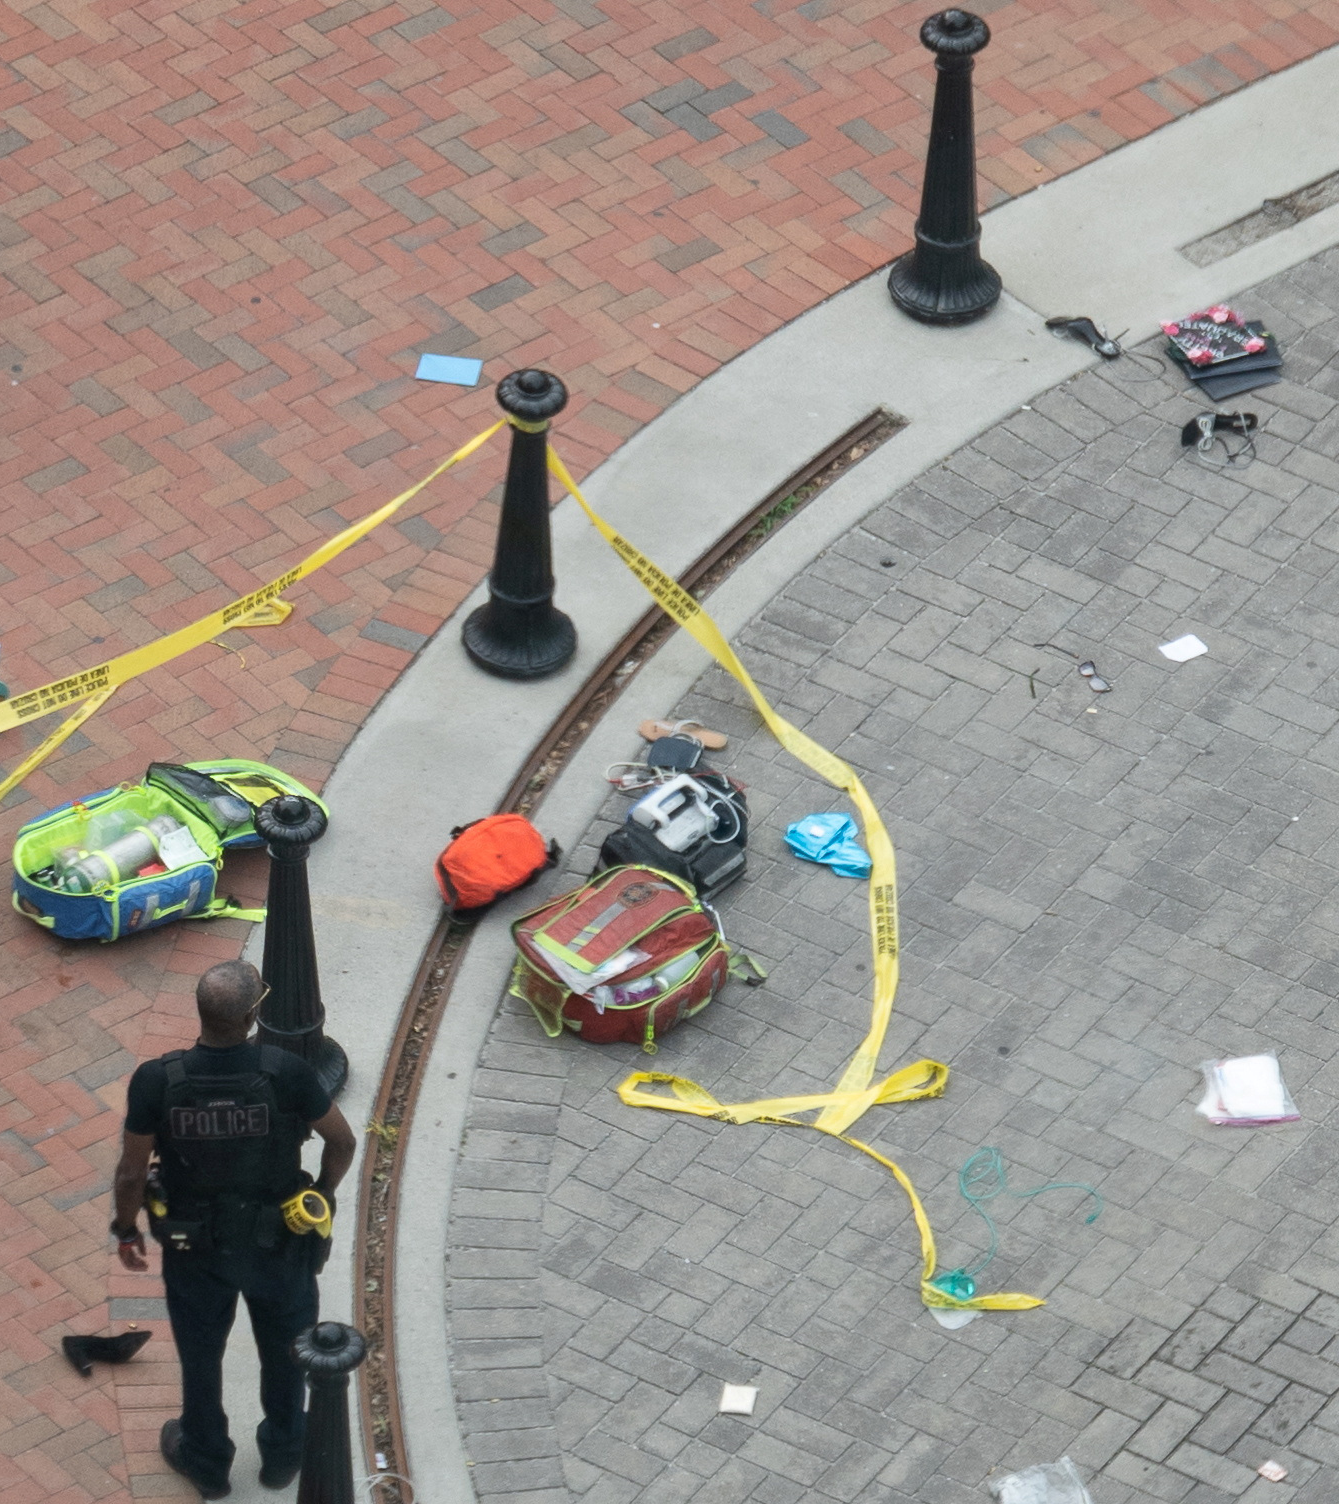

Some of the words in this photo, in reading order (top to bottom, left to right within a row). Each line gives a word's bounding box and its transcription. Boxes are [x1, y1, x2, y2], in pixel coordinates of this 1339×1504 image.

[645, 564, 673, 591] POLICIA
[651, 584, 669, 601] LINE
[669, 586, 682, 599] DE
[664, 596, 691, 622] POLICE
[77, 672, 90, 684] DE
[82, 675, 109, 693] POLICE
[56, 692, 68, 704] DO
[66, 685, 85, 699] LINE
[180, 1108, 261, 1136] POLICE
